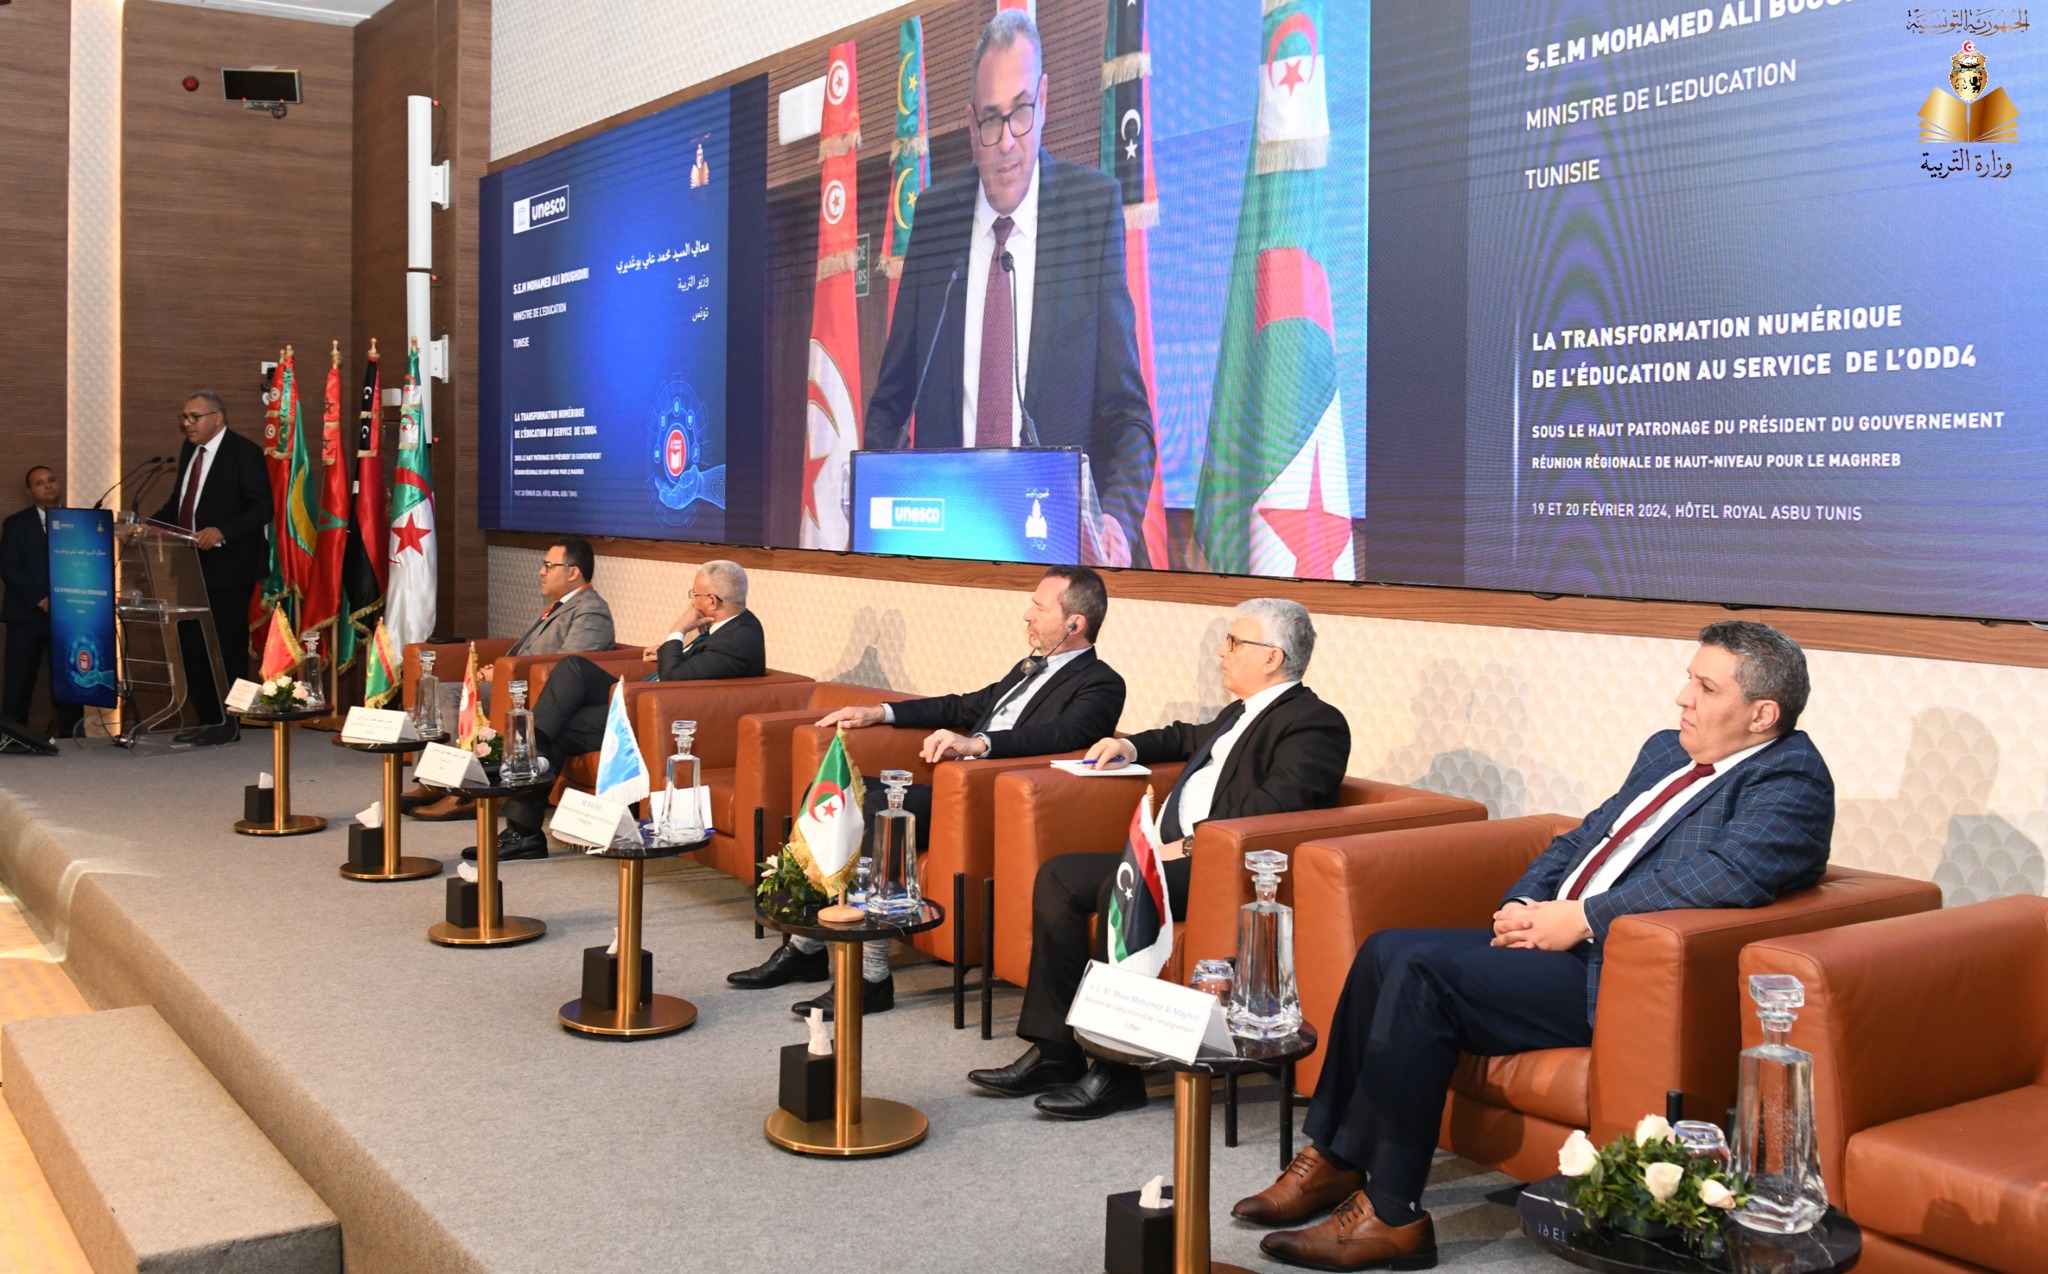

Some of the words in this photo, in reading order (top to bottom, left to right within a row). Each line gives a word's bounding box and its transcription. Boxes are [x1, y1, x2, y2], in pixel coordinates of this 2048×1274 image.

[1526, 37, 1585, 72] S.E.M
[1591, 8, 1713, 58] MOHAMED
[1719, 0, 1761, 29] ALI
[1526, 94, 1617, 131] MINISTRE
[1623, 88, 1649, 112] DE
[1525, 159, 1600, 189] TUNISIE
[531, 196, 566, 221] unesco
[1533, 332, 1557, 351] LA
[1562, 316, 1750, 349] TRANSFORMATION
[1757, 304, 1902, 336] NUMÉRIQUE
[1532, 369, 1555, 388] DE
[1696, 359, 1726, 380] AU
[1733, 353, 1831, 379] SERVICE
[1846, 350, 1878, 373] DE
[1532, 425, 1565, 439] SOUS
[1569, 424, 1584, 438] LE
[1588, 423, 1624, 437] HAUT
[1627, 420, 1710, 436] PATRONAGE
[1714, 419, 1735, 435] DU
[1739, 415, 1827, 433] PRÉSIDENT
[1832, 416, 1854, 432] DU
[1859, 412, 2005, 431] GOUVERNEMENT
[1532, 454, 1582, 469] RÉUNION
[1585, 453, 1651, 469] RÉGIONALE
[1655, 456, 1671, 469] DE
[1674, 455, 1762, 468] HAUT-NIVEAU
[1766, 454, 1804, 468] POUR
[1807, 454, 1825, 467] LE
[1829, 453, 1901, 467] MAGHREB
[895, 506, 940, 523] unesco
[1532, 503, 1544, 516] 19
[1548, 502, 1562, 516] ET
[1565, 503, 1580, 516] 20
[1583, 500, 1634, 517] FÉVRIER
[1638, 503, 1671, 519] 2024,
[1675, 501, 1719, 519] HÔTEL
[1723, 504, 1767, 520] ROYAL
[1770, 505, 1811, 520] ASBU
[1816, 505, 1862, 521] TUNIS
